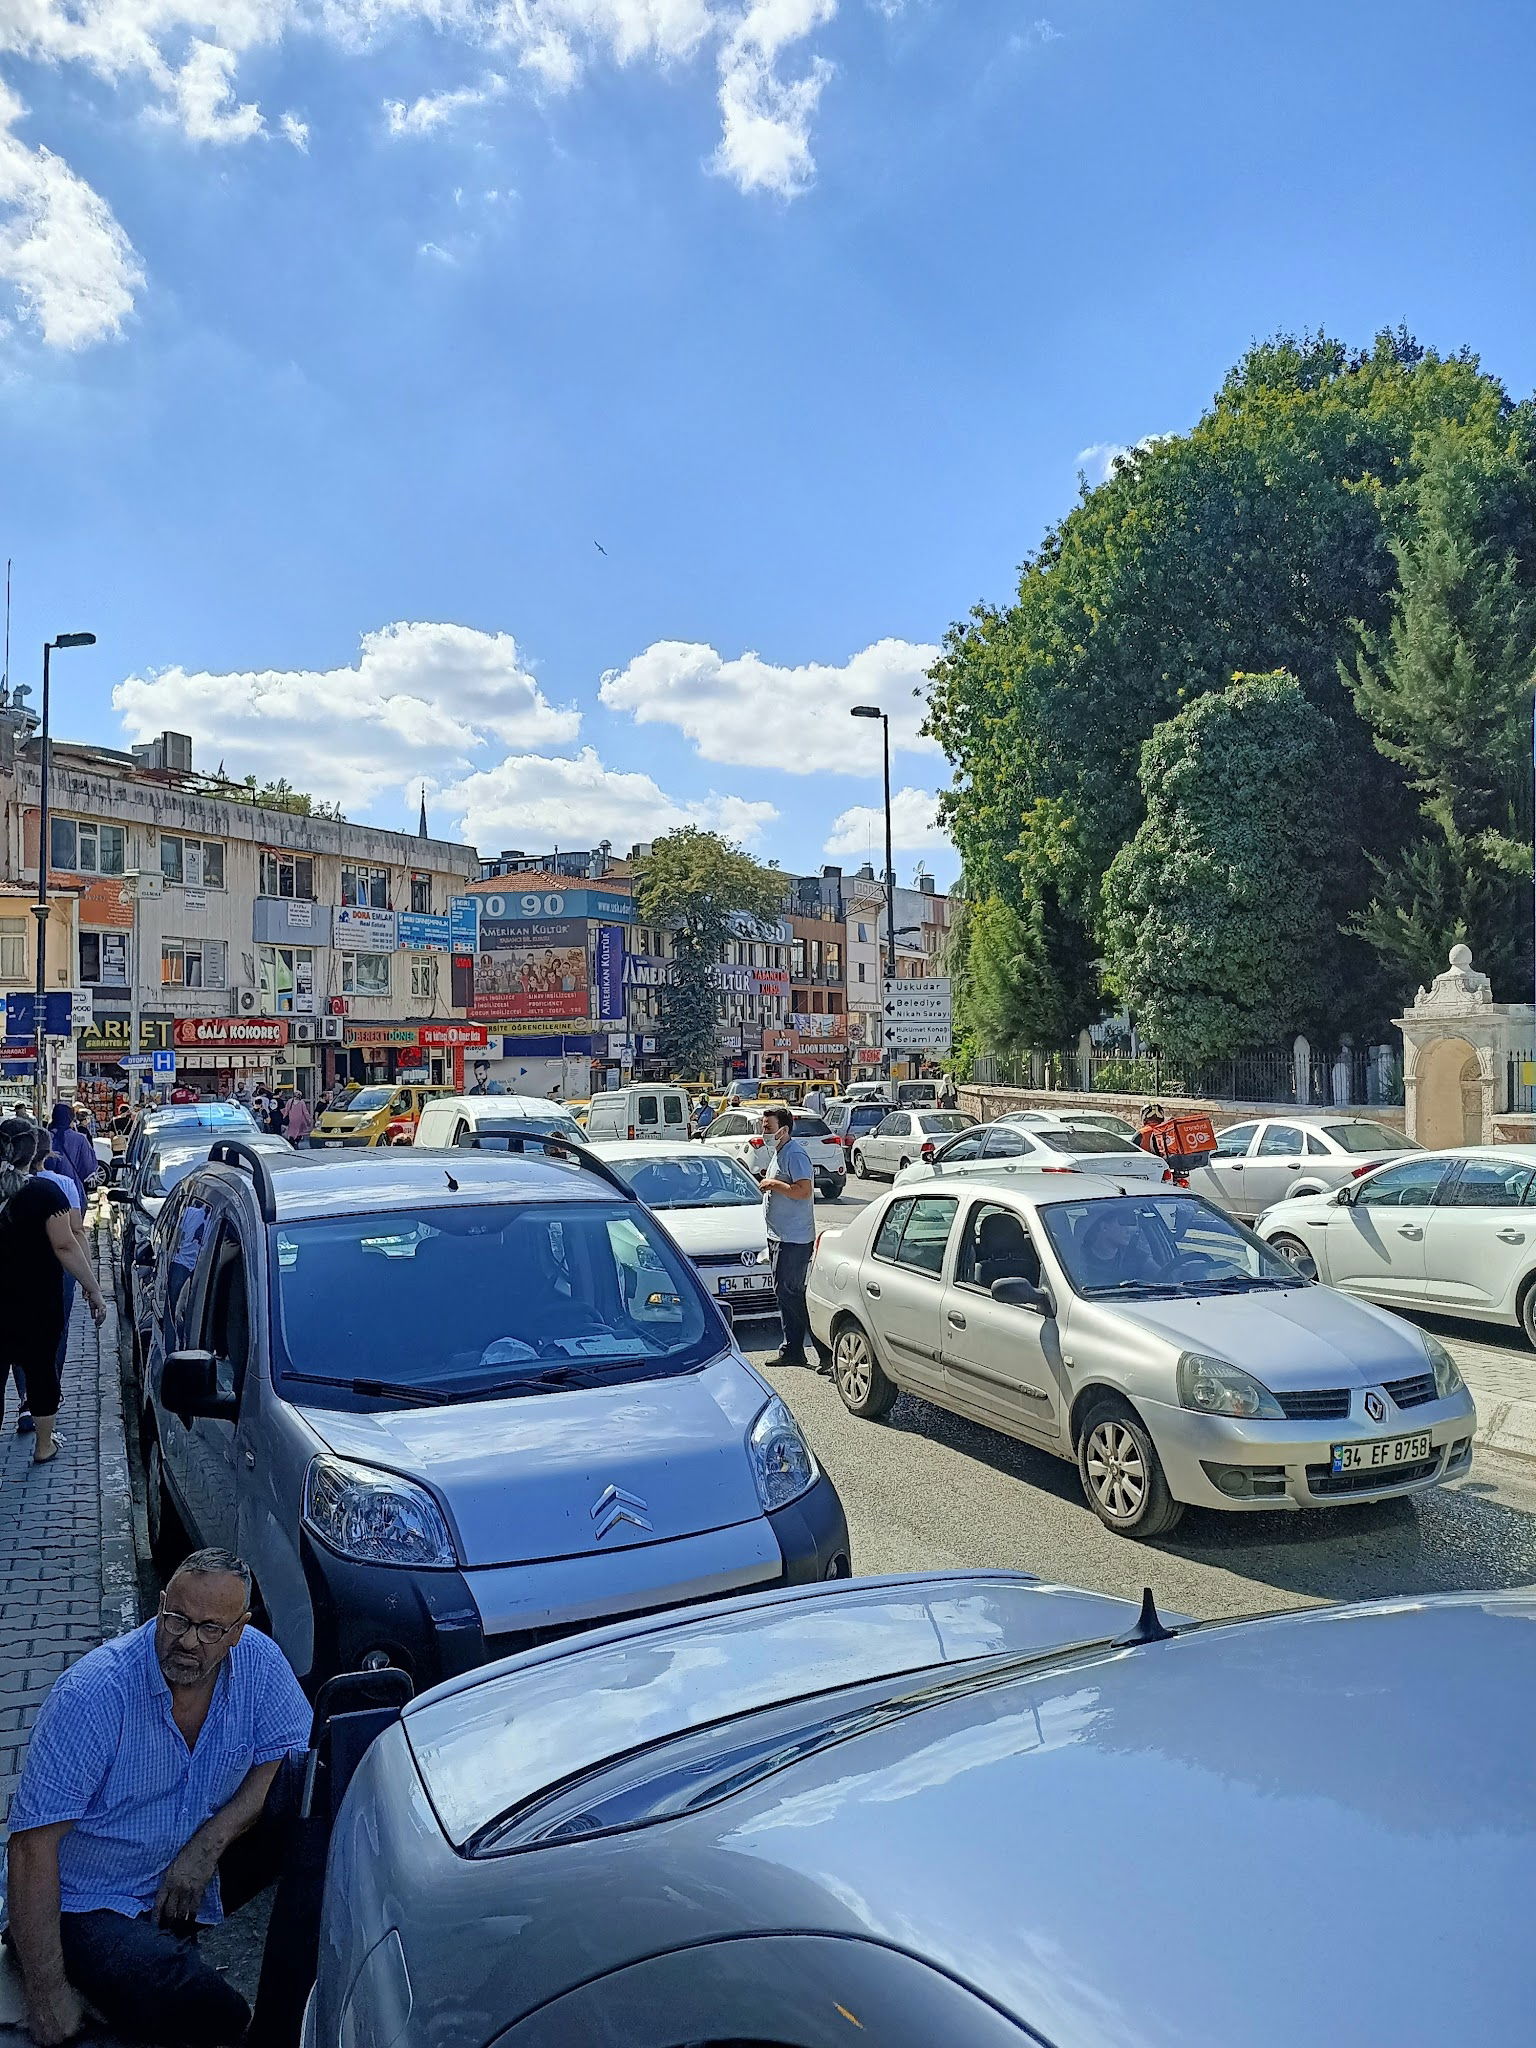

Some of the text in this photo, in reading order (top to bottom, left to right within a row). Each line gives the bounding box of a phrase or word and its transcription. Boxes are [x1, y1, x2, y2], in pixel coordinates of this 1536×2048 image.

[521, 894, 564, 916] 90
[353, 910, 393, 921] DORA EMLAK
[896, 999, 942, 1008] Belediye
[896, 1010, 950, 1018] Nikah Sarayı
[197, 1025, 280, 1043] GALA KOKOREÇ
[488, 1024, 508, 1032] RSİTE
[389, 1029, 415, 1041] DÖNER
[896, 1035, 947, 1043] Selami Ali
[157, 1054, 171, 1070] H
[1184, 1123, 1208, 1132] trendyol
[1186, 1132, 1207, 1149] go
[726, 1279, 737, 1290] 34
[743, 1277, 755, 1289] RL
[1343, 1448, 1362, 1468] 34
[1371, 1444, 1390, 1465] EF
[1394, 1437, 1428, 1461] 8758
